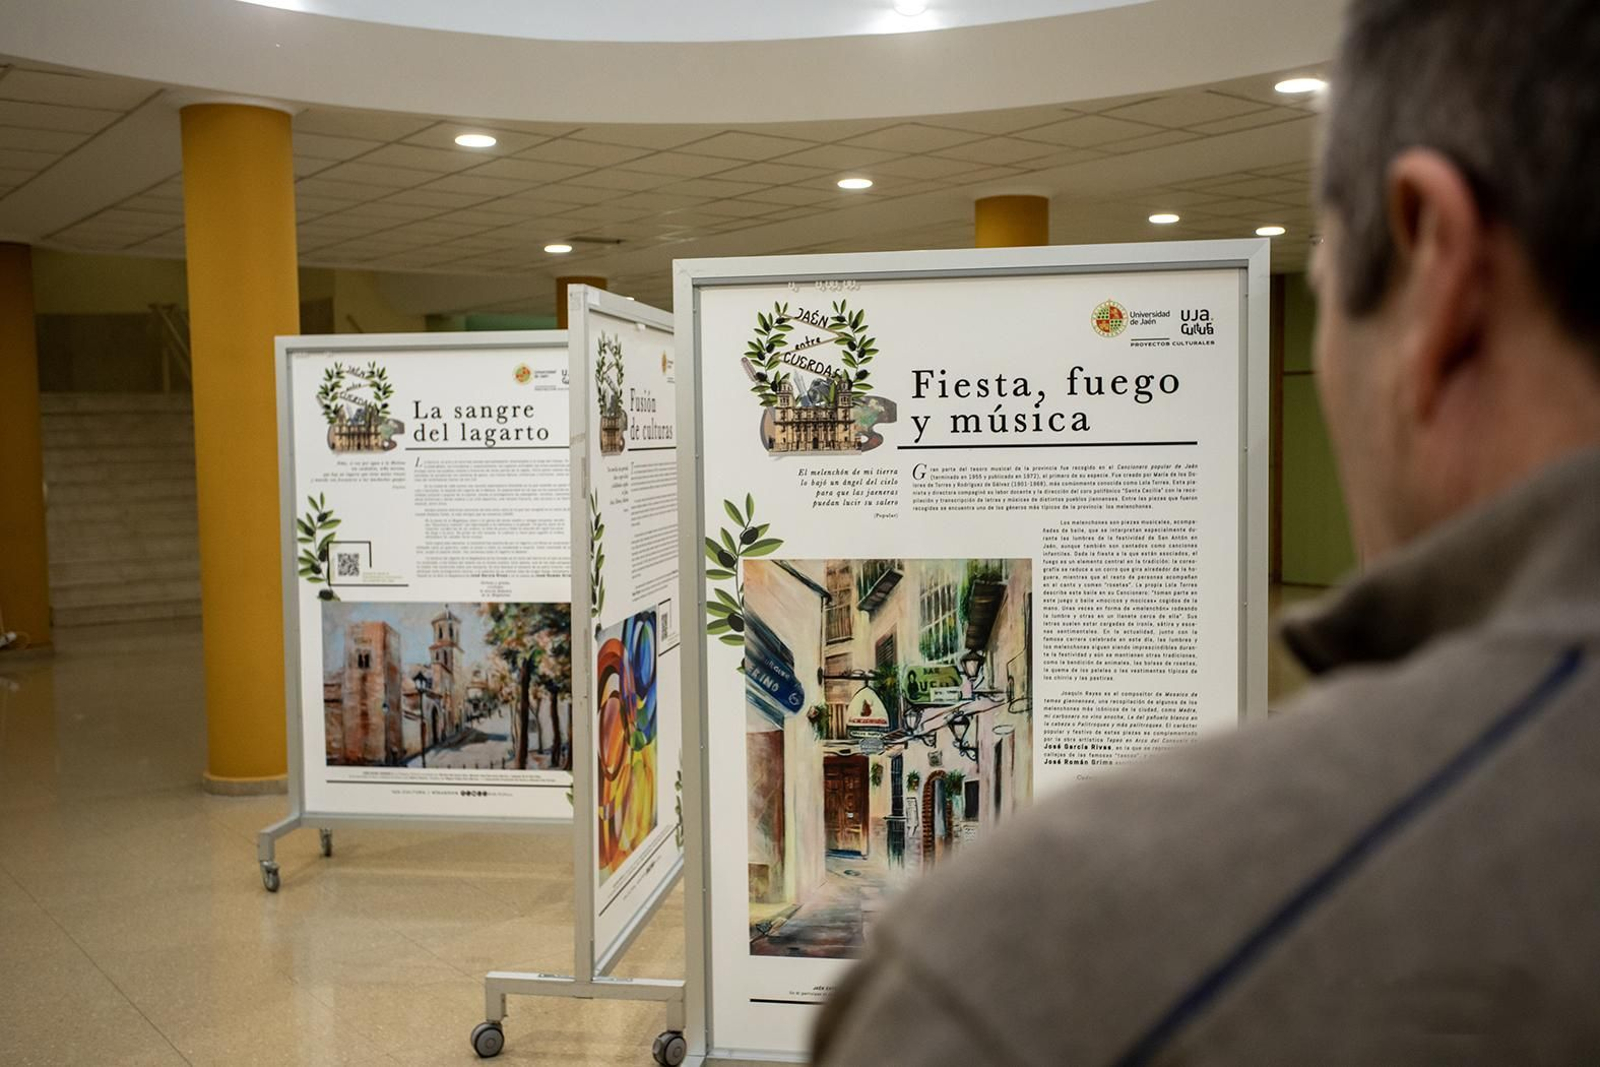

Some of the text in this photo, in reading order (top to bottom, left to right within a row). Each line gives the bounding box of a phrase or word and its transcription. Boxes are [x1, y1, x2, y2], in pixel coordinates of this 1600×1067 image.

[795, 308, 829, 328] JAÉN
[1130, 310, 1170, 318] Universidad
[795, 336, 821, 350] entre
[784, 352, 842, 379] CUERDAS
[911, 366, 1180, 404] Fiesta, fuego
[412, 400, 535, 424] La sangre
[630, 388, 656, 412] Fusión
[413, 422, 550, 448] del lagarto
[630, 416, 673, 440] de culturas
[911, 404, 1092, 444] y música
[810, 479, 826, 487] bajó
[842, 479, 862, 487] ángel
[866, 489, 898, 497] jaeneras
[812, 499, 839, 508] puedan
